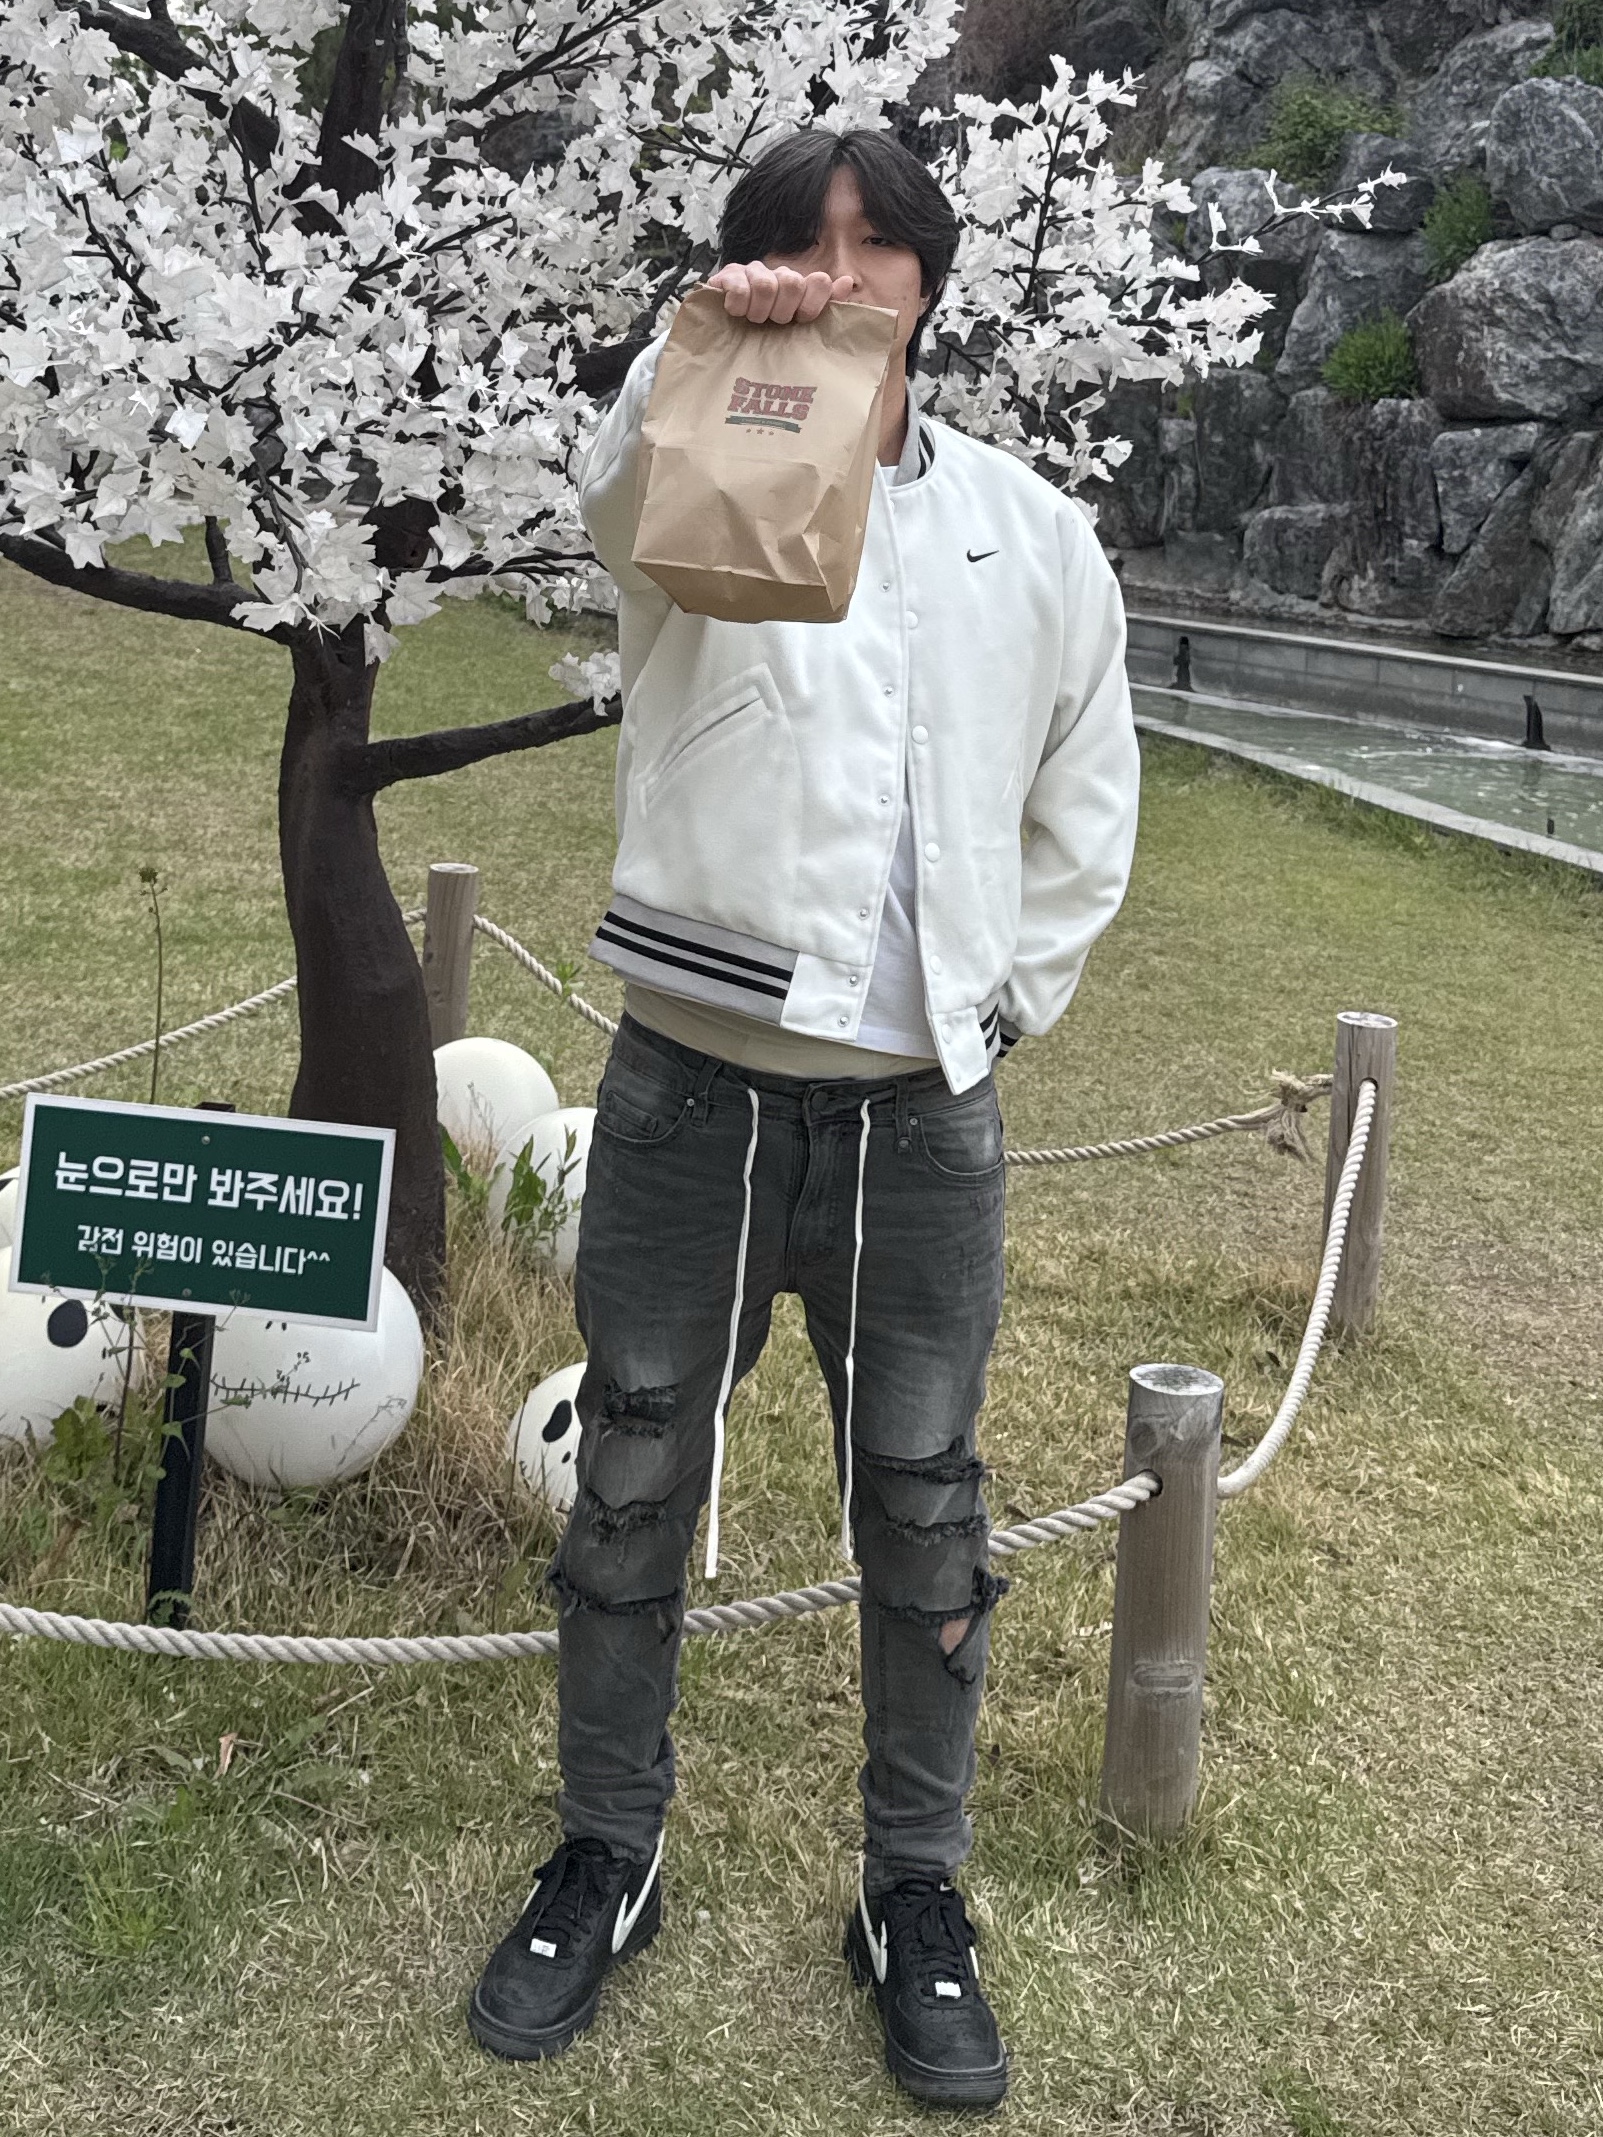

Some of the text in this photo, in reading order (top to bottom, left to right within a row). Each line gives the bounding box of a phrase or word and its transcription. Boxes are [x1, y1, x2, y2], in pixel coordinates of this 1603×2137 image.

[727, 393, 810, 421] FALLS
[733, 377, 818, 404] STONE
[55, 1151, 363, 1220] 눈으로만 봐주세요!
[77, 1224, 124, 1255] 감전
[131, 1230, 203, 1264] 위험이
